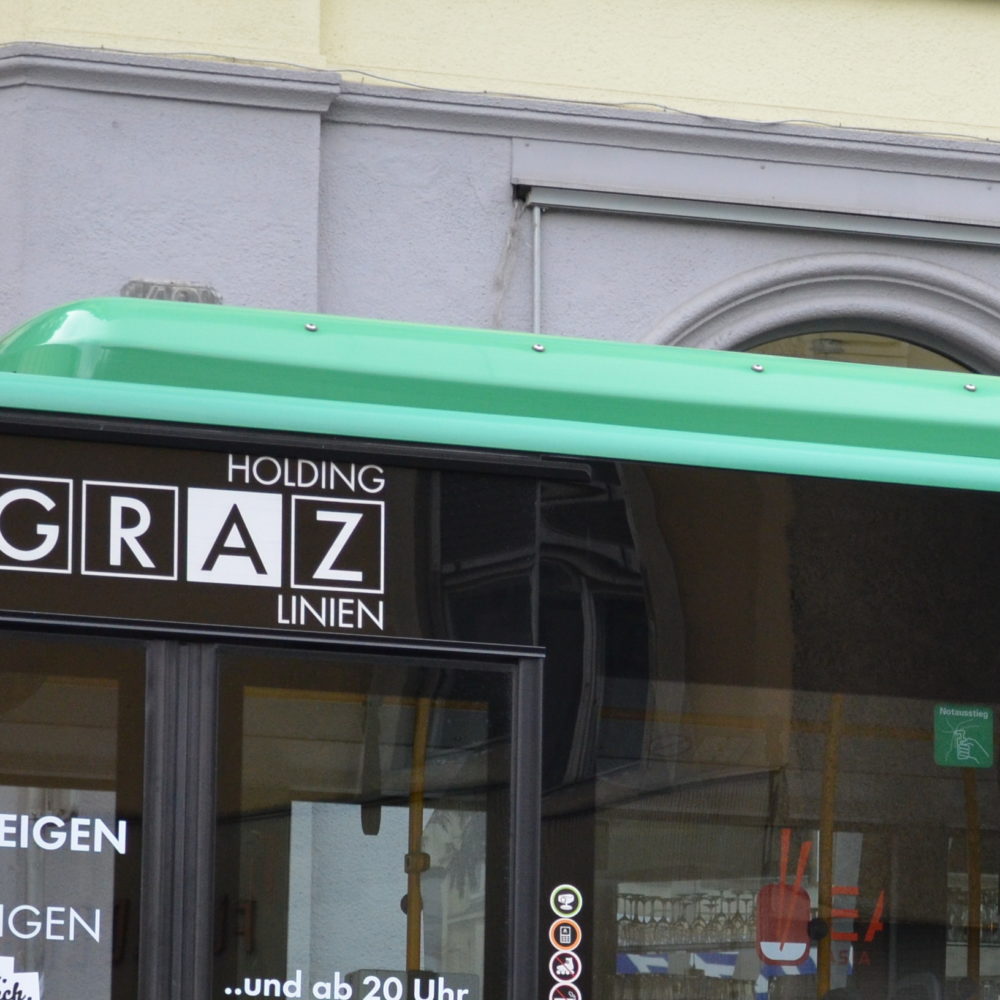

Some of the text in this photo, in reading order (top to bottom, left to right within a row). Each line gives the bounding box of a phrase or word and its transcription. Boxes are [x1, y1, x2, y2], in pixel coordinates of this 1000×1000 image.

[228, 453, 385, 494] HOLDING
[0, 488, 364, 582] GRAZ
[277, 594, 384, 630] LINIEN
[312, 971, 353, 1000] ab
